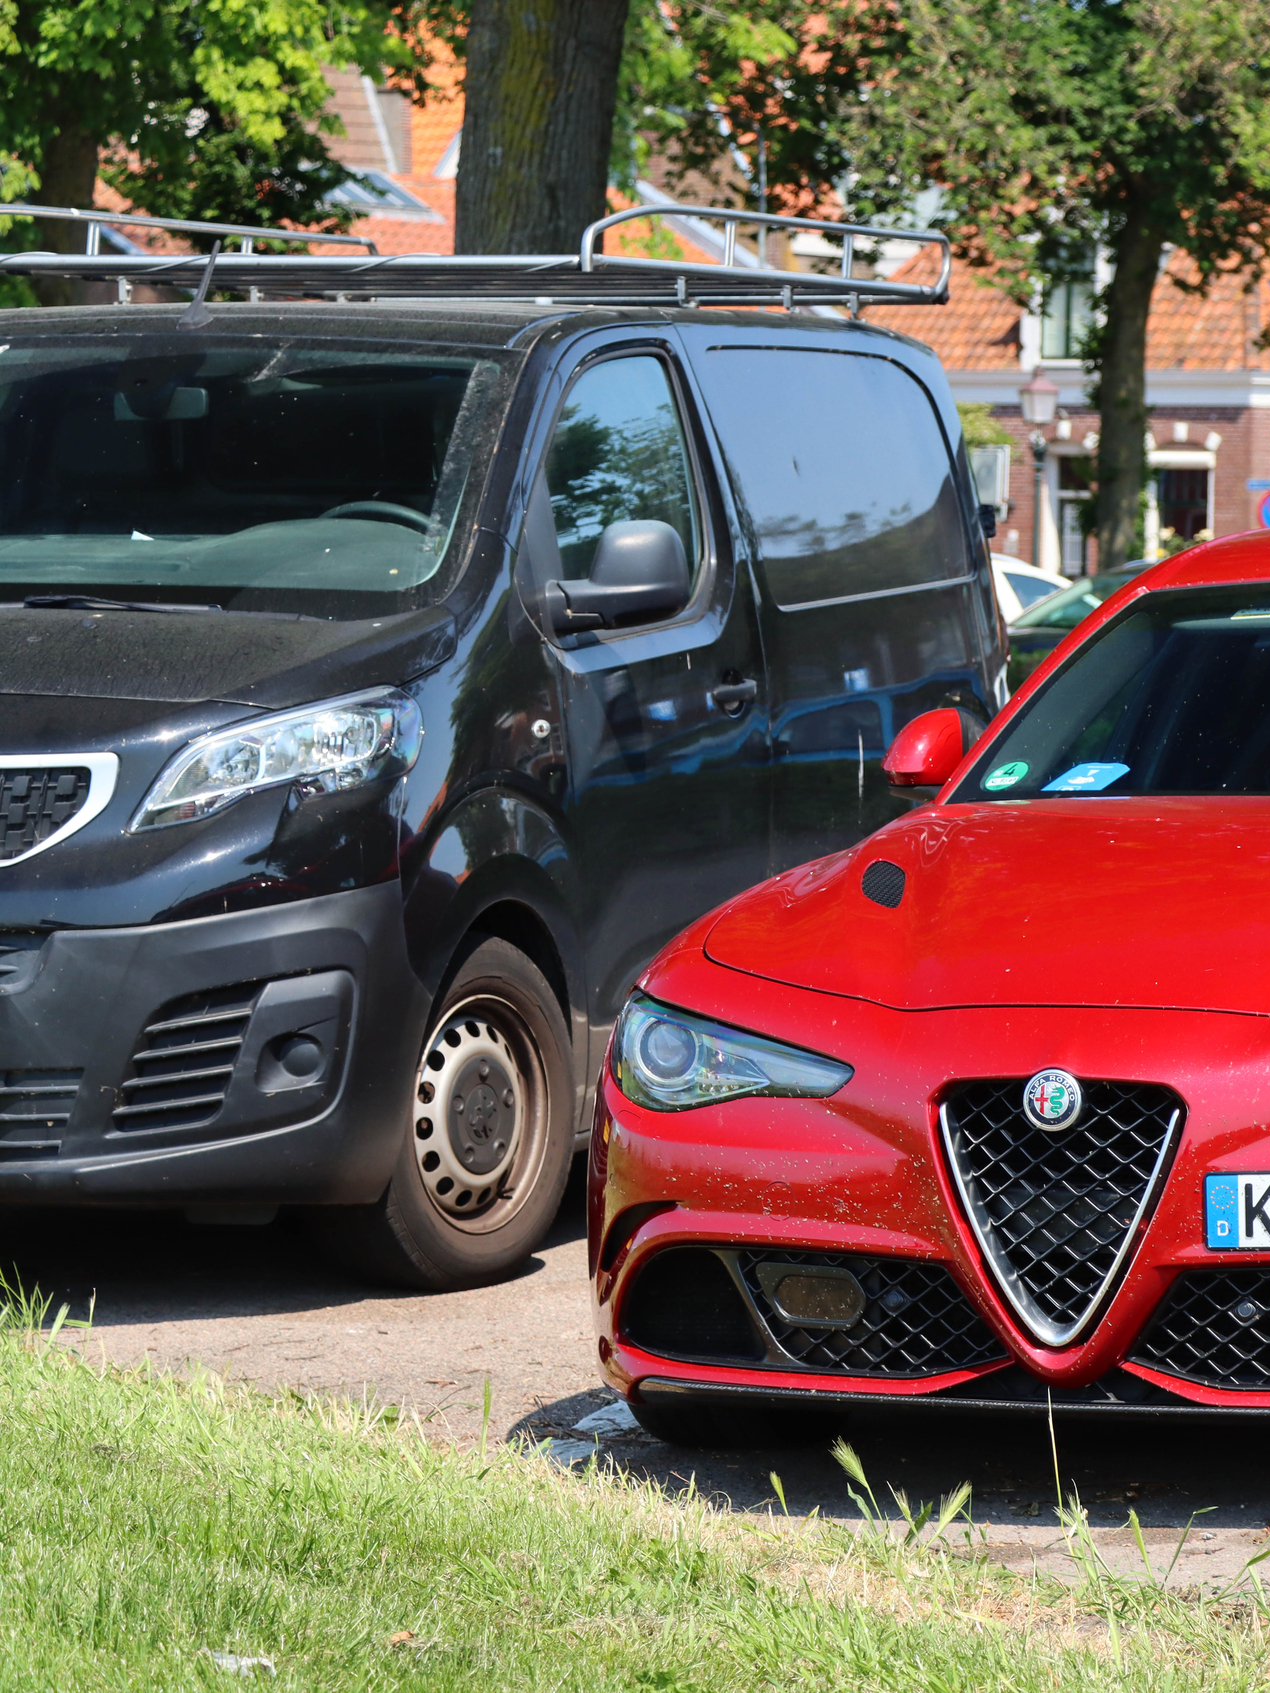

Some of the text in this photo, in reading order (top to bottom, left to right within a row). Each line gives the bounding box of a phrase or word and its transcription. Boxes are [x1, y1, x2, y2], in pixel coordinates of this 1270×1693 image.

[1003, 763, 1018, 776] 4
[1029, 1075, 1075, 1101] ALFA ROMEO
[1217, 1220, 1229, 1237] D
